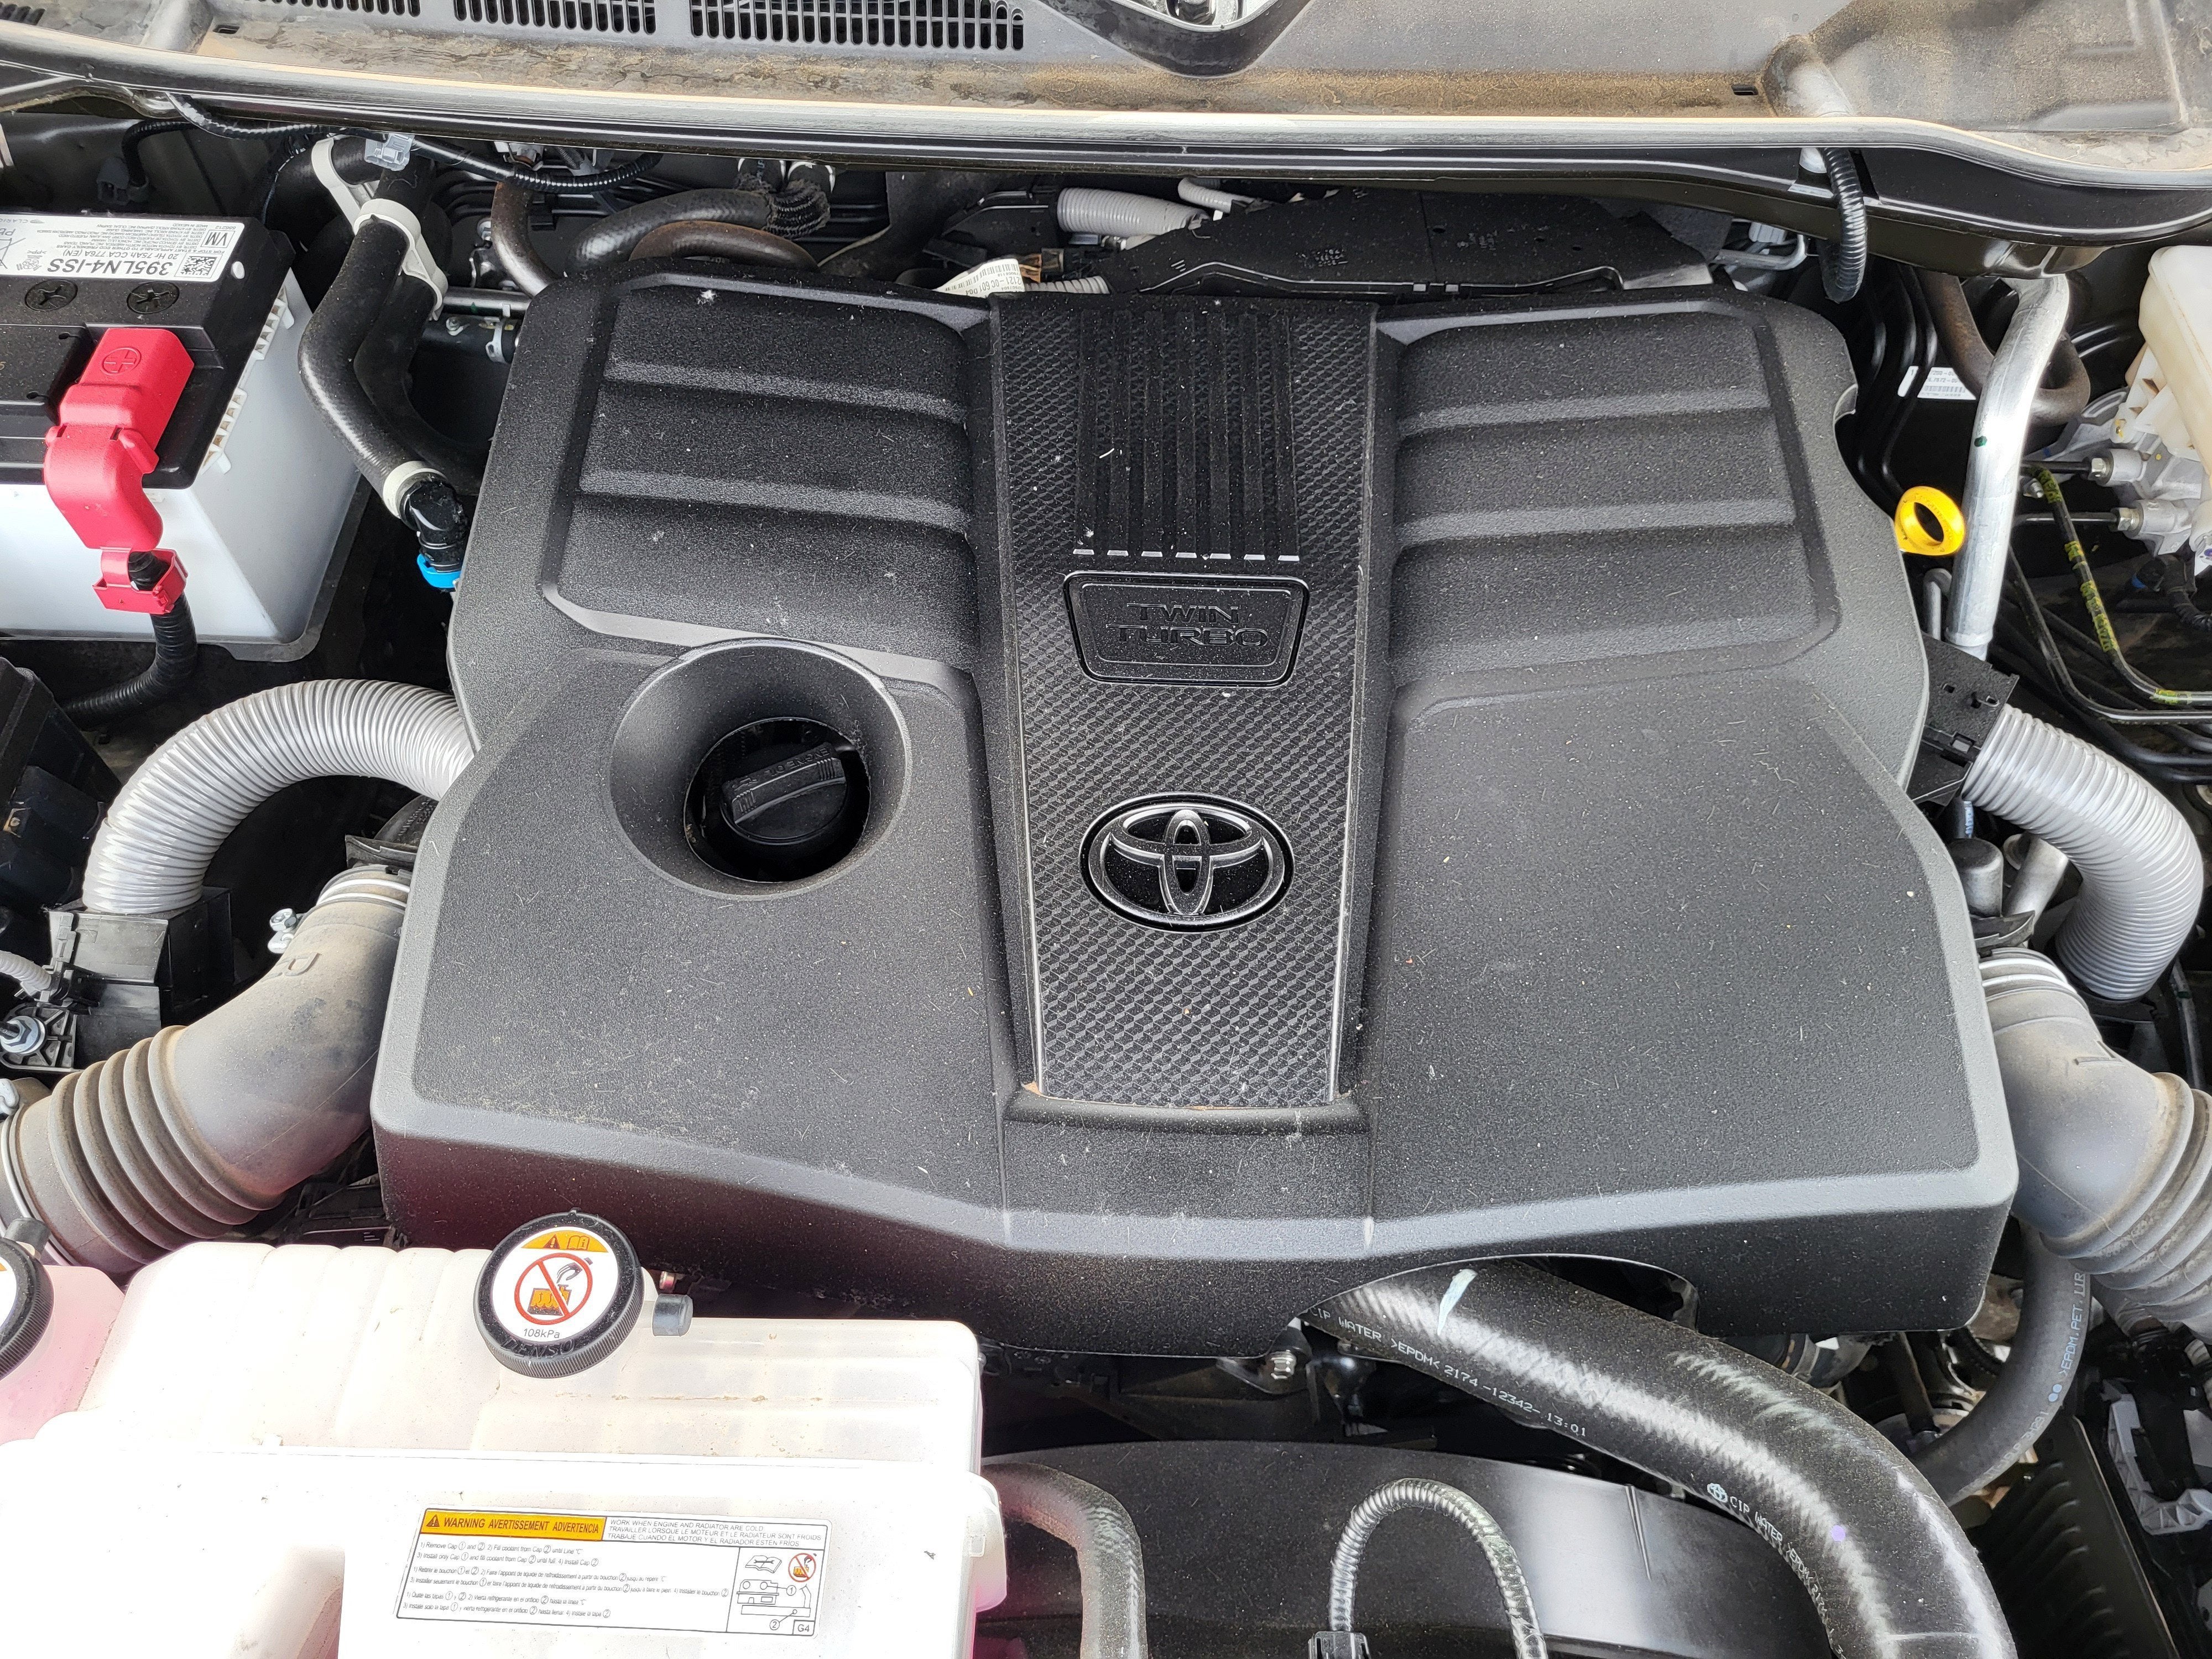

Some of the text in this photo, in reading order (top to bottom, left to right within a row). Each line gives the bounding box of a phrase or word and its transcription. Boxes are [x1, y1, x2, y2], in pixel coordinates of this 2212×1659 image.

[204, 232, 228, 246] VM
[62, 248, 82, 257] (EN)
[47, 258, 173, 275] 395LN4-ISS
[1126, 602, 1239, 624] TWIN
[1105, 623, 1269, 648] TURBO
[764, 747, 830, 777] ENGINE OIL
[524, 1328, 560, 1339] 108kPa
[501, 1338, 574, 1359] DENSO
[1338, 1316, 1381, 1342] WATER
[1390, 1338, 1440, 1370] >EPDM<
[1444, 1364, 1479, 1387] 2174
[444, 1517, 598, 1533] WARNING AVERTISSEMENT ADVERTENCIA
[1730, 1496, 1750, 1514] CIP
[1755, 1511, 1783, 1542] WATER
[797, 1624, 810, 1632] G4
